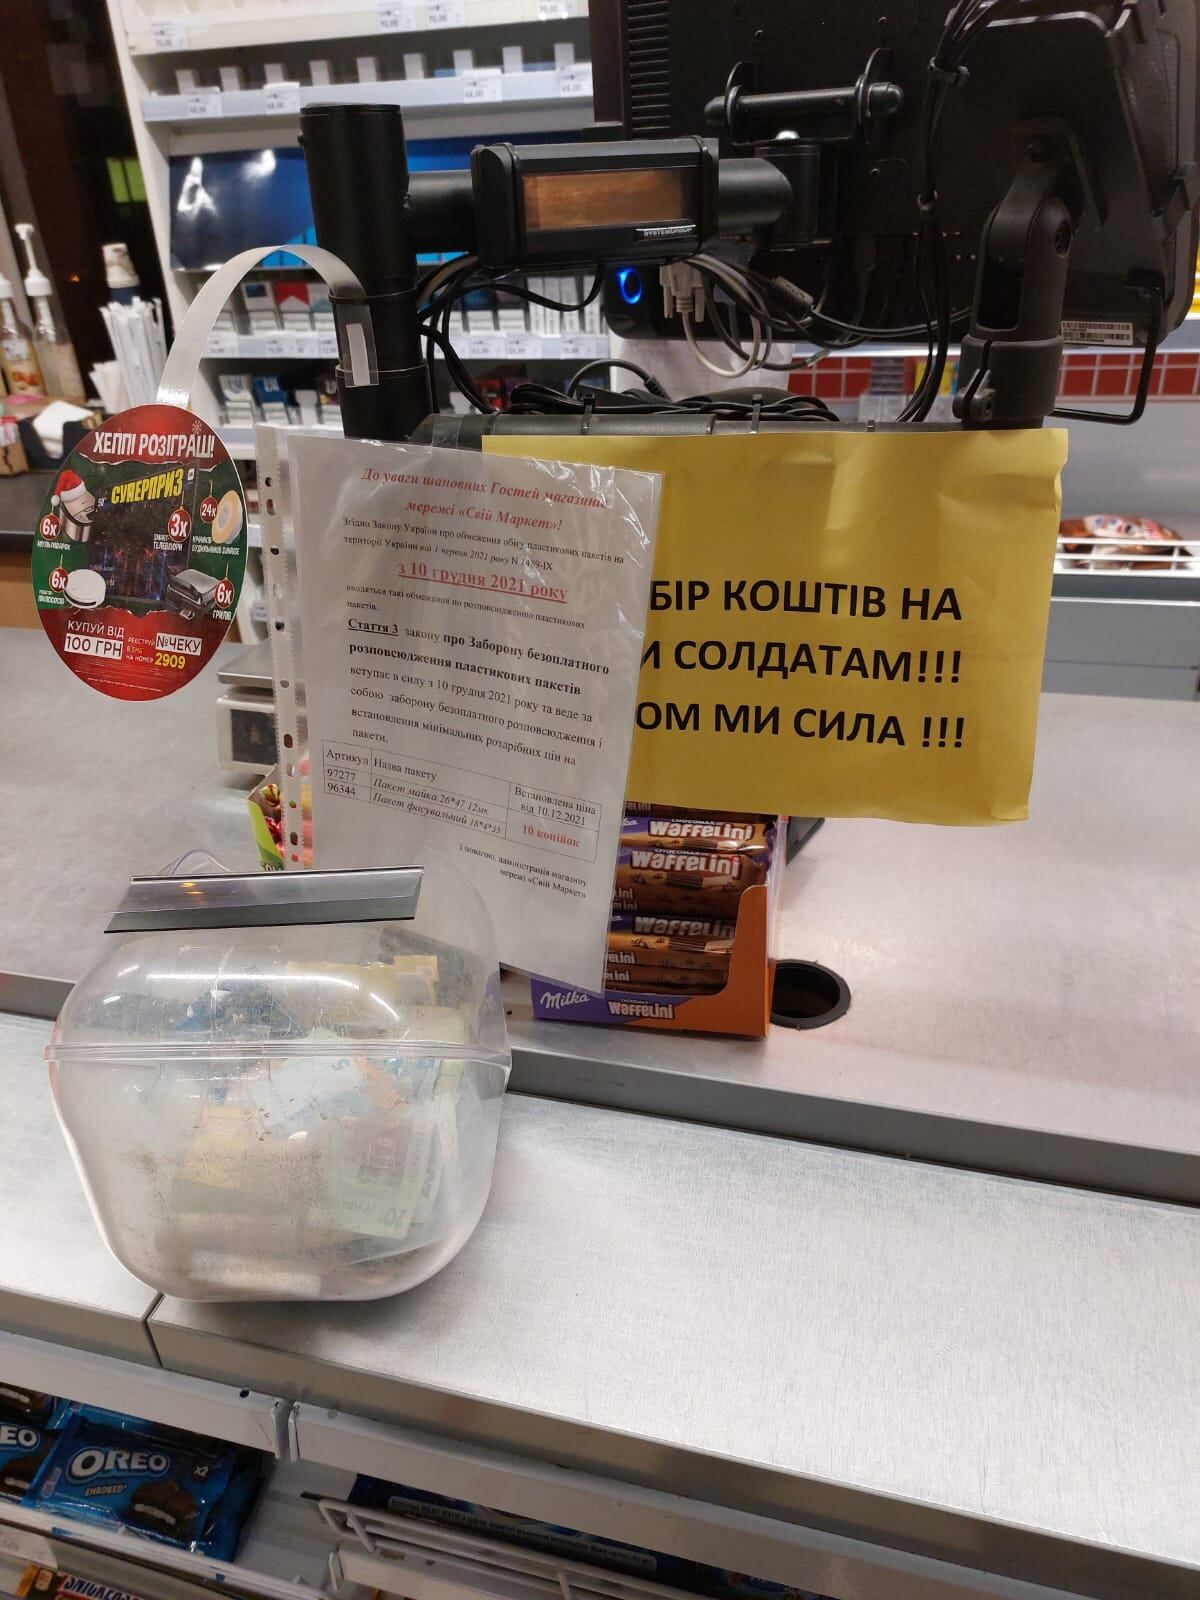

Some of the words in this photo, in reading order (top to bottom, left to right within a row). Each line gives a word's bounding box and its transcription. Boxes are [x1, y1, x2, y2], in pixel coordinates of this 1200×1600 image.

[93, 432, 135, 454] ХЕППІ
[138, 434, 215, 458] РОЗІГРАШ!
[111, 468, 183, 505] СУПЕРПРИЗ
[361, 468, 380, 481] До
[382, 472, 419, 485] уваги
[422, 476, 488, 493] шановних
[490, 482, 540, 500] Гостей
[406, 501, 456, 517] мережі
[458, 506, 493, 521] «Свій
[495, 511, 563, 531] Маркет»!
[343, 517, 370, 528] Згідно
[372, 520, 402, 533] Закону
[403, 523, 437, 536] України
[439, 530, 455, 539] про
[456, 531, 501, 545] обмеження
[503, 536, 525, 550] обігу
[527, 541, 579, 557] пластикових
[581, 550, 612, 562] пакетів
[614, 556, 624, 564] на
[344, 536, 382, 548] території
[384, 538, 418, 551] України
[419, 544, 432, 552] від
[441, 547, 468, 558] червня
[469, 550, 488, 561] 2021
[489, 554, 508, 566] року
[511, 557, 518, 565] N
[411, 562, 427, 577] 10
[432, 568, 486, 588] грудня
[490, 574, 525, 593] 2021
[531, 584, 568, 600] року
[388, 588, 404, 598] такі
[405, 591, 450, 605] обмеження
[535, 614, 585, 629] пластикових
[724, 580, 886, 618] КОШТІВ
[901, 587, 962, 620] НА
[67, 620, 105, 636] КУПУЙ
[107, 626, 125, 640] ВІД
[66, 636, 92, 653] 100
[95, 640, 122, 657] ГРН
[155, 652, 185, 669] 2909
[348, 618, 388, 633] Стаття
[392, 624, 399, 634] 3
[404, 627, 440, 643] закону
[443, 634, 465, 647] про
[468, 635, 523, 659] Заборону
[527, 648, 609, 675] безоплатного
[674, 640, 961, 683] СОЛДАТАМ!!!
[349, 643, 452, 668] розповсюдження
[455, 660, 531, 685] пластикових
[535, 677, 581, 695] пакетів
[350, 666, 391, 680] вступає
[401, 674, 426, 687] силу
[437, 679, 448, 690] 10
[451, 685, 486, 698] грудня
[488, 690, 511, 705] 2021
[514, 698, 539, 712] року
[542, 704, 553, 714] та
[555, 707, 579, 720] веде
[582, 713, 593, 722] за
[351, 687, 384, 700] собою
[390, 694, 435, 711] заборону
[438, 702, 505, 725] безоплатного
[507, 719, 596, 748] розповсюдження
[714, 704, 780, 735] МИ
[793, 708, 905, 746] СИЛА
[922, 716, 965, 748] !!!
[352, 728, 389, 743] пакети.
[352, 708, 419, 728] встановлення
[422, 721, 483, 743] мінімальних
[486, 737, 541, 757] роздрібних
[544, 750, 560, 763] цін
[564, 755, 576, 765] на
[326, 748, 369, 766] Артикул
[374, 758, 402, 773] Назва
[404, 766, 437, 783] пакету
[327, 768, 356, 781] 97277
[327, 782, 356, 796] 96344
[373, 778, 406, 793] Пакет
[407, 789, 437, 801] майка
[468, 802, 488, 815] 12мк
[373, 792, 405, 808] Пакет
[406, 803, 467, 825] фасувальний
[515, 787, 573, 809] Встановлена
[576, 803, 596, 815] ціна
[520, 803, 534, 814] від
[538, 805, 586, 826] 10.12.2021
[523, 824, 534, 835] 10
[536, 829, 580, 848] копійок
[500, 868, 526, 881] мережі
[551, 871, 586, 887] магазину
[540, 991, 590, 1010] Milka
[71, 1449, 168, 1478] OREO
